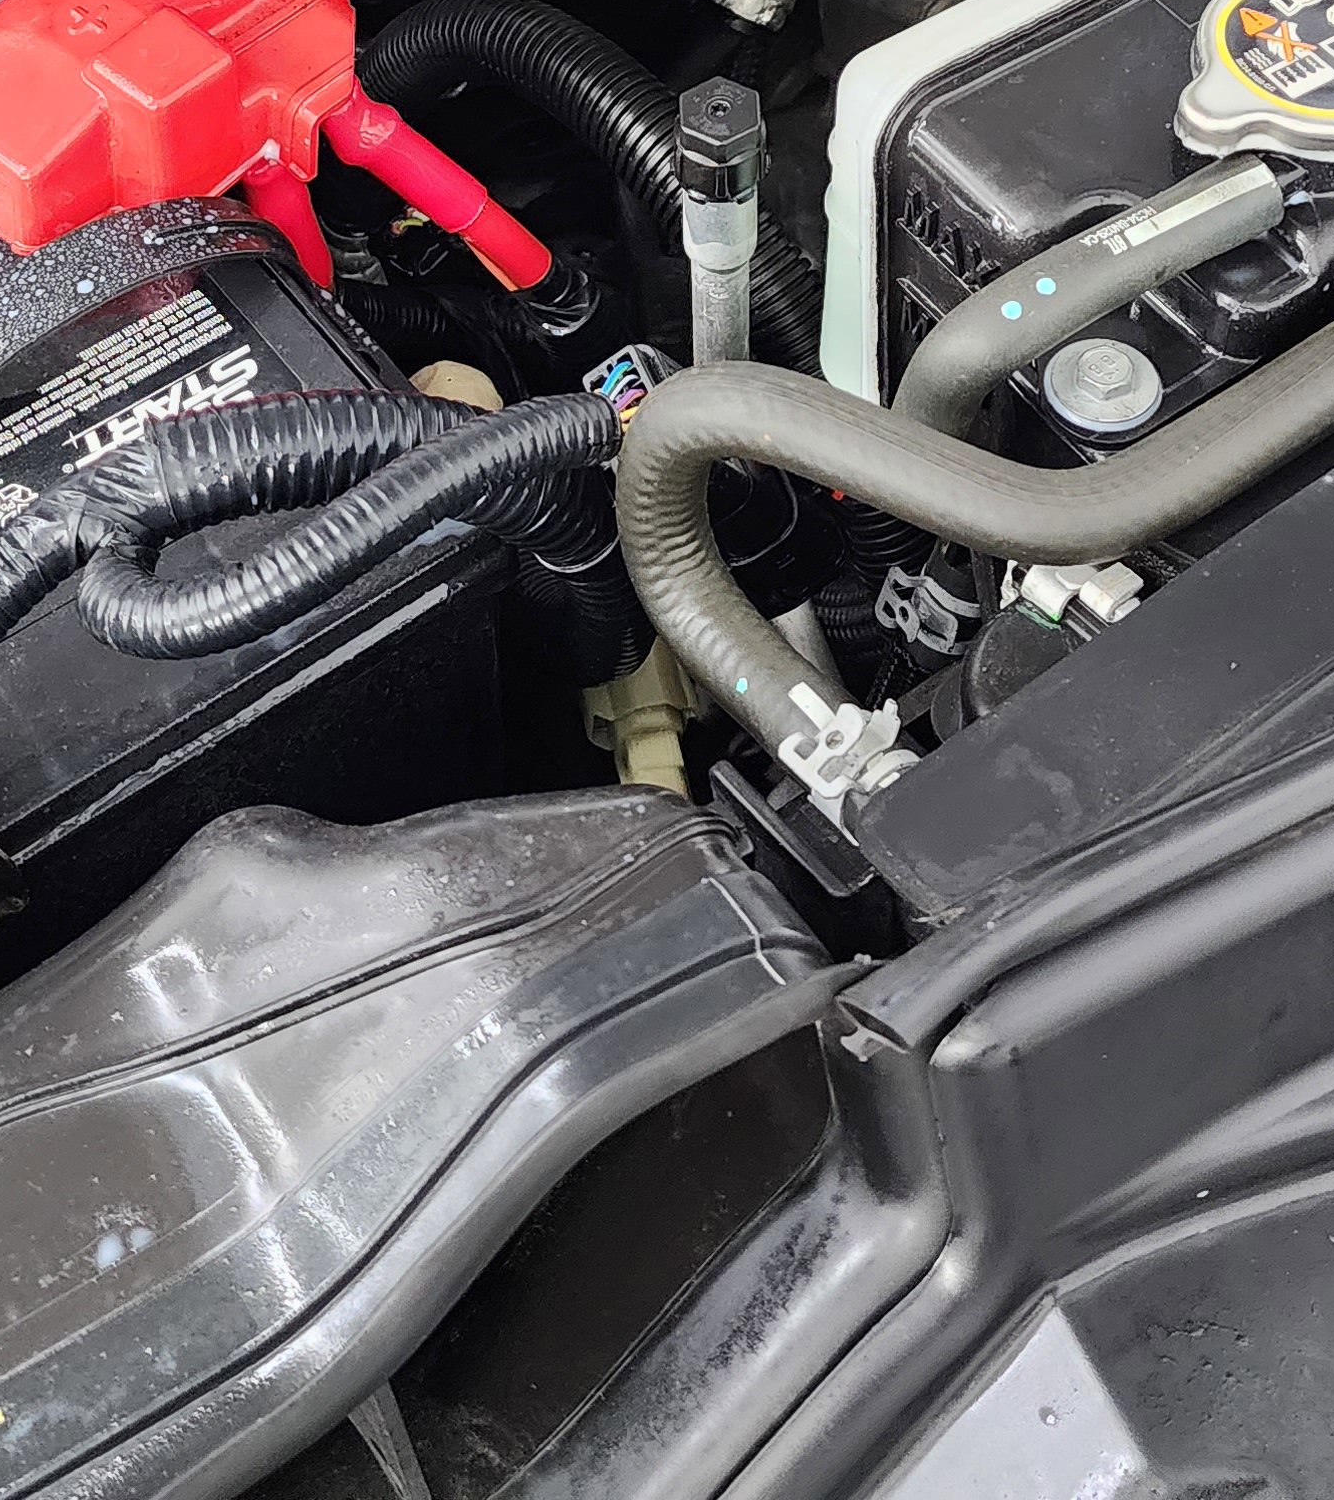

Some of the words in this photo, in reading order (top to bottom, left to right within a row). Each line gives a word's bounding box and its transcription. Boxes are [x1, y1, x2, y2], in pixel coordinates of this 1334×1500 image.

[177, 287, 204, 308] WASH
[121, 317, 150, 338] AFTER
[152, 329, 170, 344] and
[162, 336, 180, 352] and
[30, 395, 51, 412] also
[34, 401, 63, 423] known
[74, 344, 259, 471] START
[0, 405, 33, 429] contain
[25, 415, 37, 427] to
[35, 406, 76, 436] terminals
[11, 420, 28, 435] the
[19, 427, 38, 444] and
